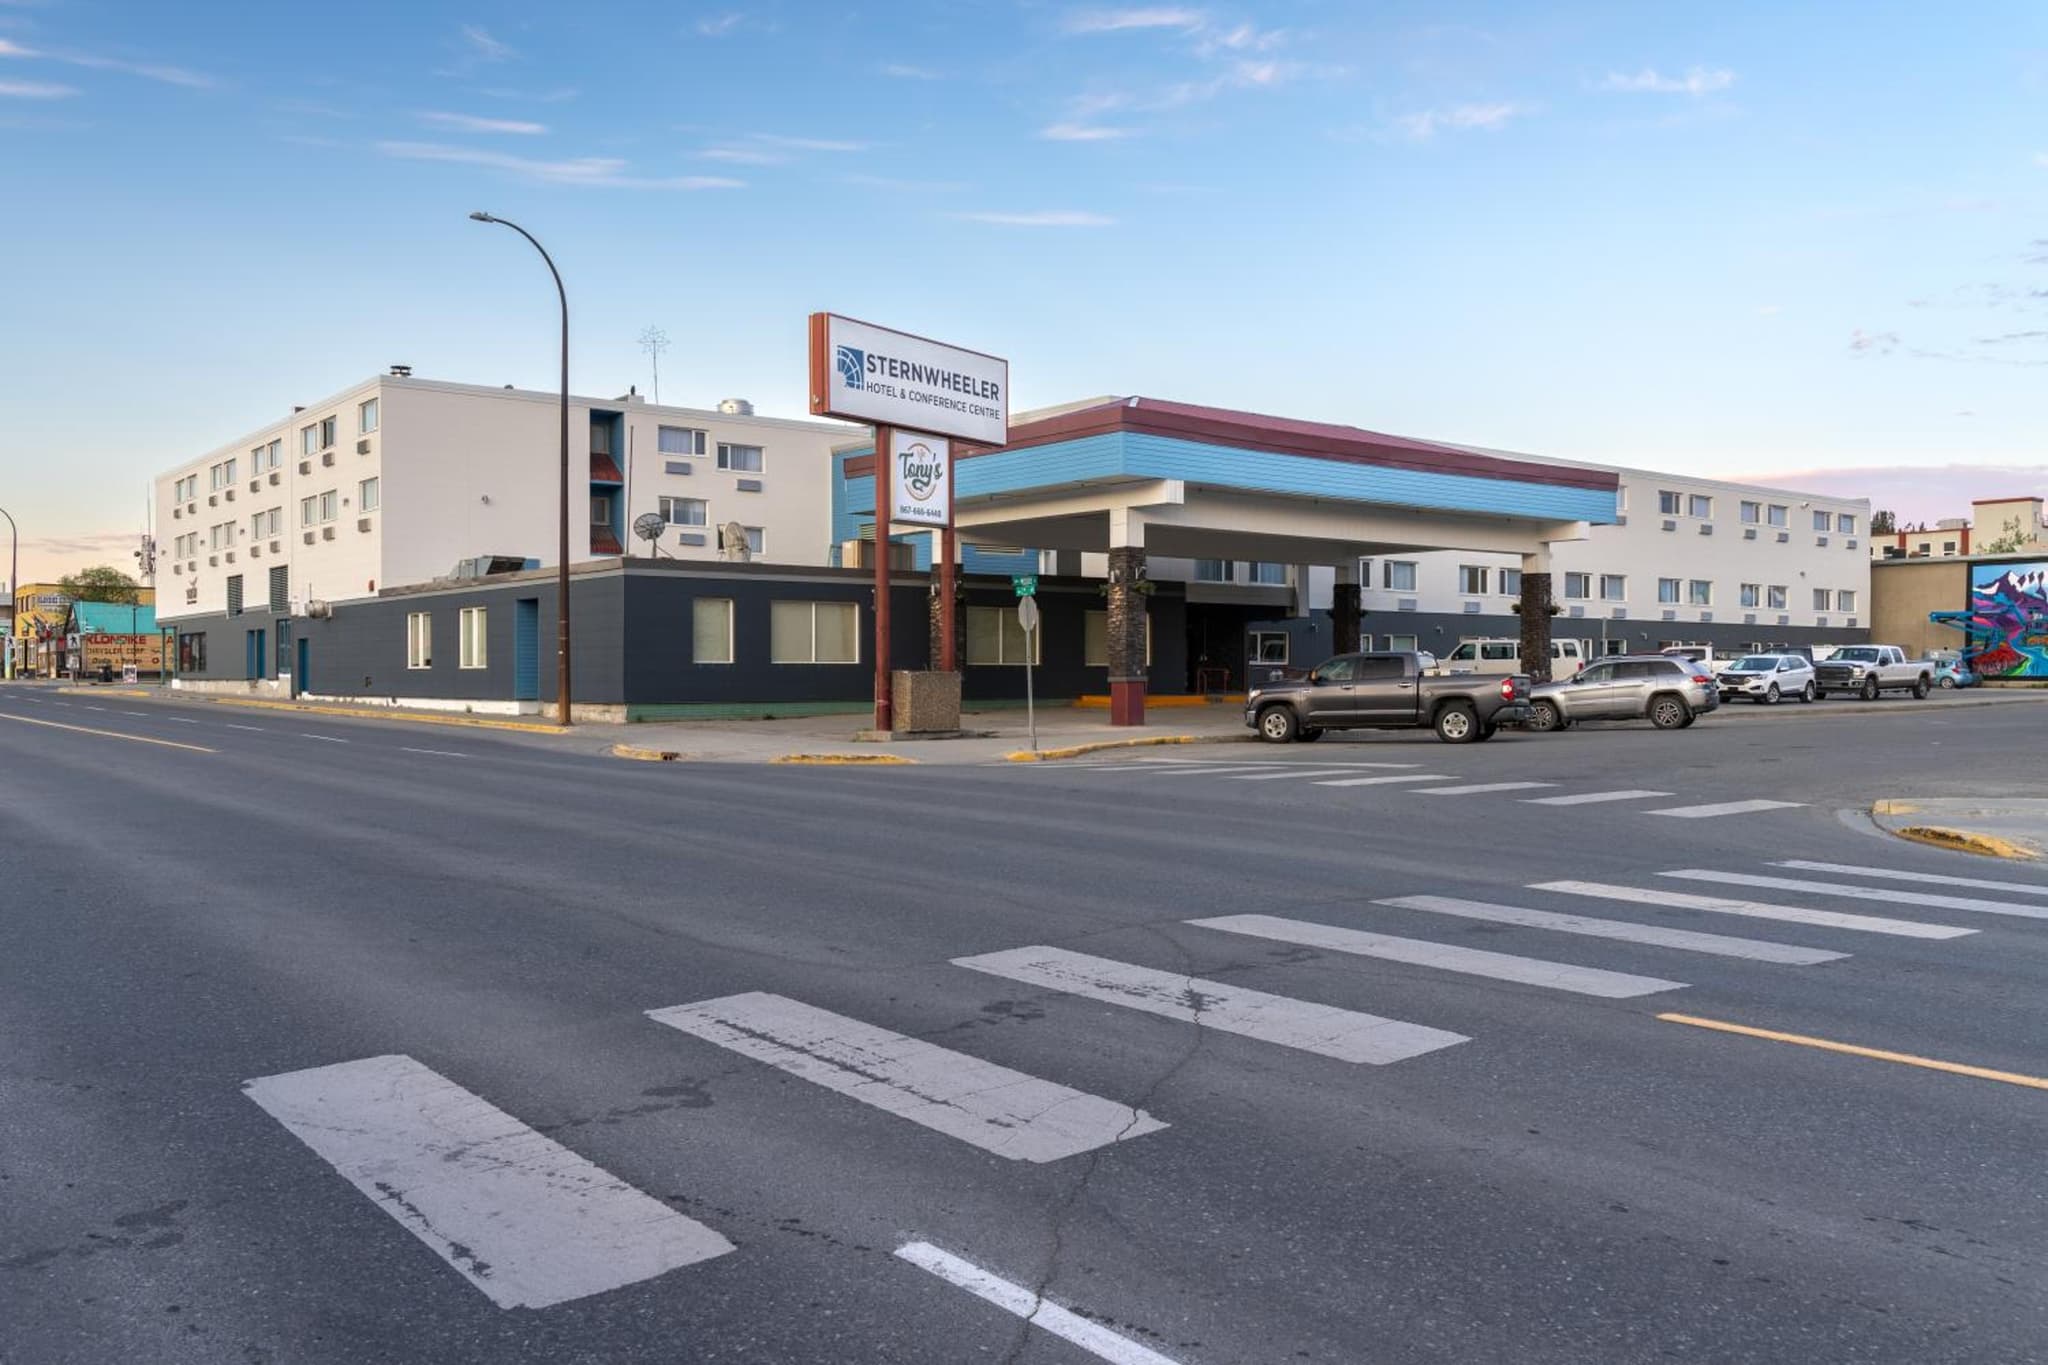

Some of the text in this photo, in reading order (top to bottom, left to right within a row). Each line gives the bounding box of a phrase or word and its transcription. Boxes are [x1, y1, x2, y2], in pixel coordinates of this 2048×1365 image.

[866, 353, 1000, 401] STERNWHEELER
[866, 381, 1000, 420] HOTEL & CONFERENCE CENTRE
[898, 452, 943, 493] Tony's
[86, 635, 146, 645] KLONDIKE
